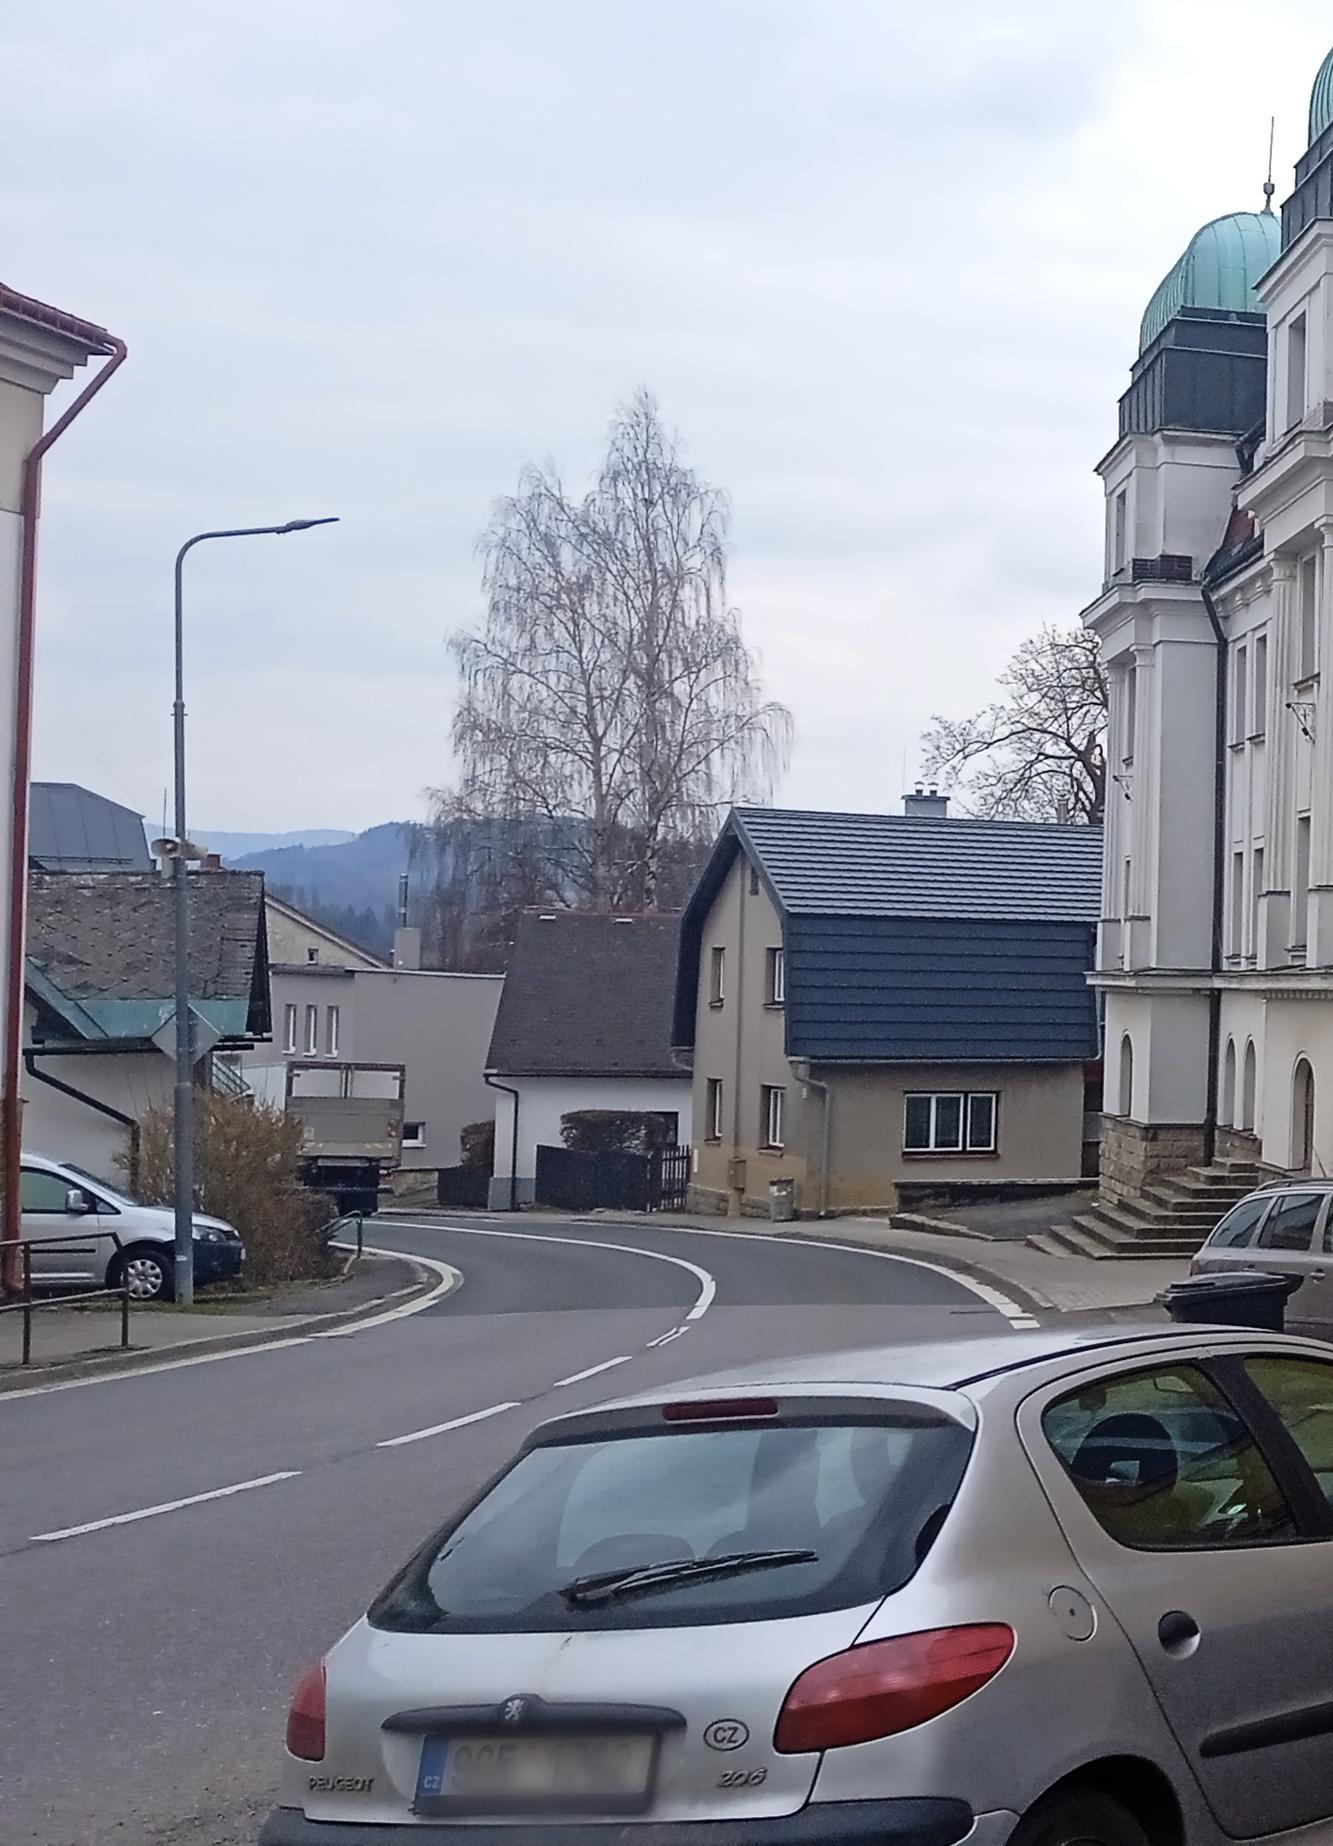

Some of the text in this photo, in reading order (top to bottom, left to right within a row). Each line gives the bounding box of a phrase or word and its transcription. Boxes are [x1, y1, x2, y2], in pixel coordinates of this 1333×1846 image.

[713, 1726, 740, 1744] CZ
[309, 1776, 375, 1793] PEUGEOT
[423, 1775, 441, 1789] CZ
[716, 1766, 768, 1788] 206
